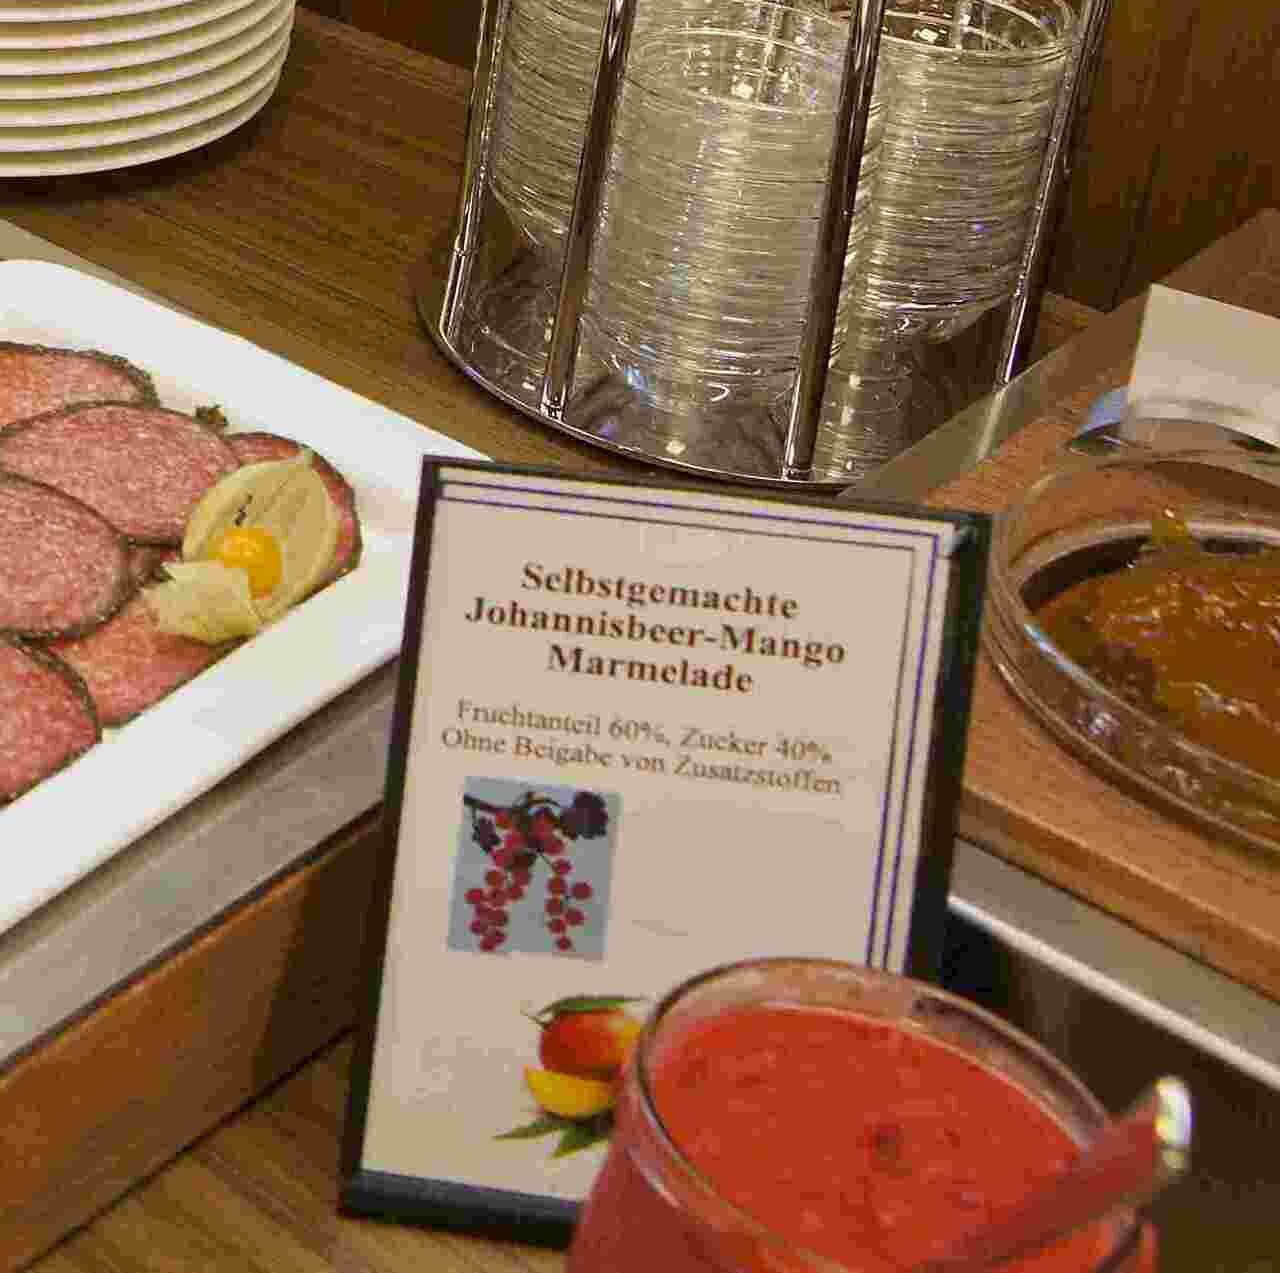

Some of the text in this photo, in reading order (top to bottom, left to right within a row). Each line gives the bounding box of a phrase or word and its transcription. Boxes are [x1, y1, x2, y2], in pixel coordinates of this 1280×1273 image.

[521, 561, 800, 620] Selbstgemachte
[464, 596, 848, 669] Johannisbeer-Mango
[548, 643, 754, 693] Marmelade
[457, 697, 602, 737] Fruchtanteil
[608, 717, 672, 749] 60%,
[678, 727, 769, 757] Zucker
[440, 727, 843, 798] Ohne Beigabe von Zusatzstoffen
